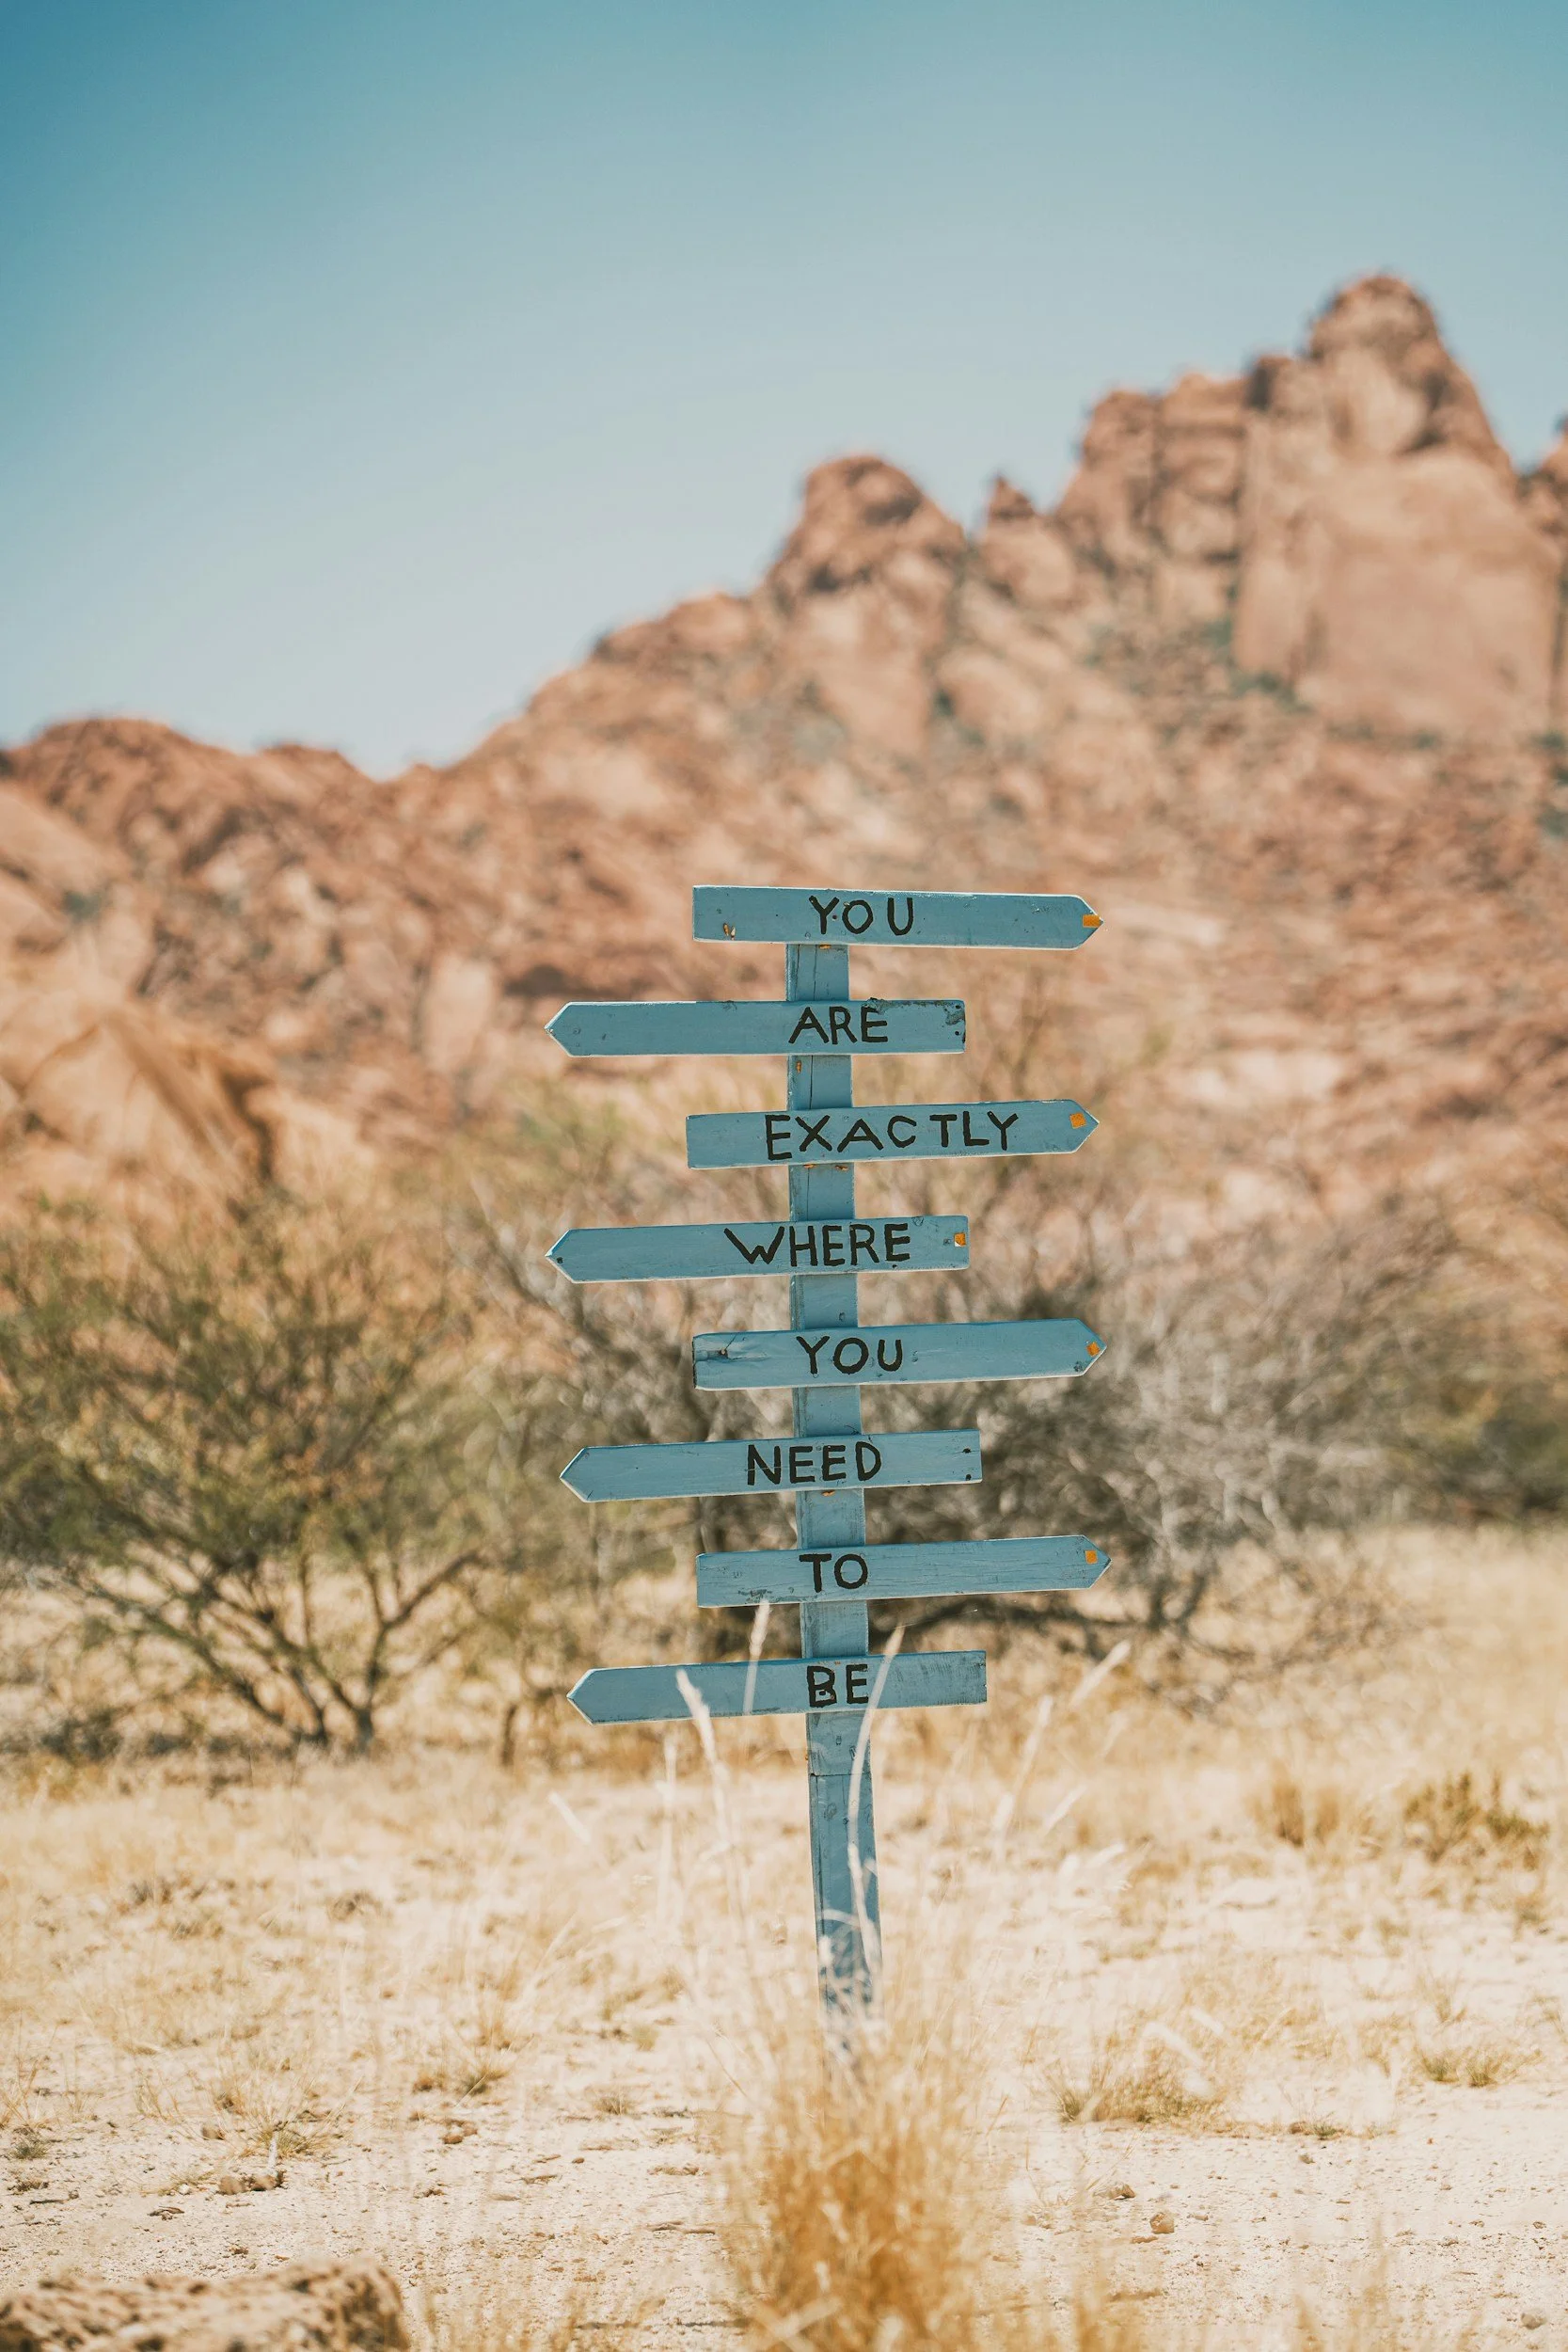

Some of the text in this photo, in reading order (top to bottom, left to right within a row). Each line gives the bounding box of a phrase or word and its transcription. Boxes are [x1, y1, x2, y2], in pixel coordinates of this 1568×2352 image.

[808, 895, 915, 936] YOU
[787, 1006, 889, 1045] ARE
[765, 1110, 1019, 1161] EXACTLY
[723, 1223, 911, 1267] WHERE
[796, 1335, 904, 1375] YOU
[747, 1440, 882, 1486] NEED
[799, 1553, 868, 1593] TO
[806, 1663, 870, 1708] BE
